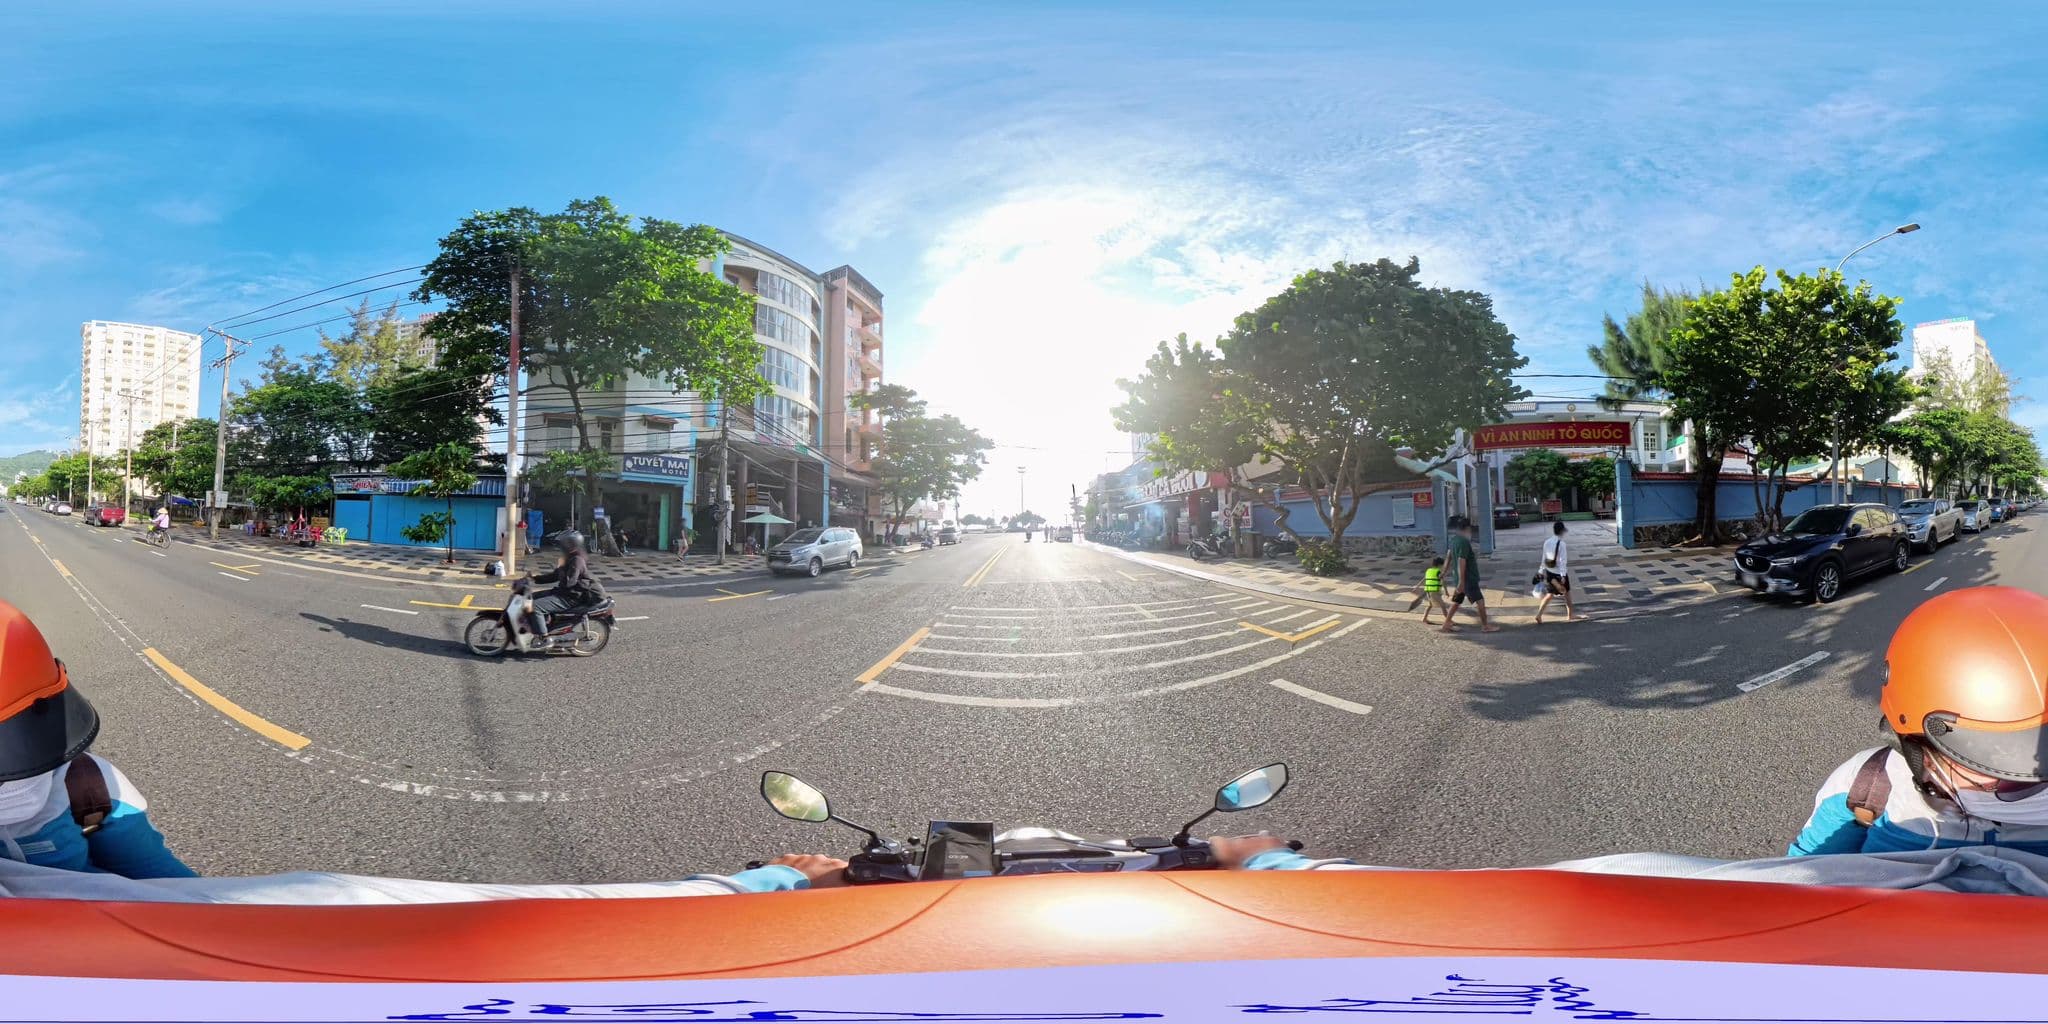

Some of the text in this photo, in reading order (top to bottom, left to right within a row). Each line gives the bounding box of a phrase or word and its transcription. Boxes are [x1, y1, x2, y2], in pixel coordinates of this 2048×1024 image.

[1481, 423, 1624, 444] VÌ AN NINH TỔ QUỐC
[632, 456, 689, 471] TUYẾT MAI
[661, 468, 689, 476] MOTEL
